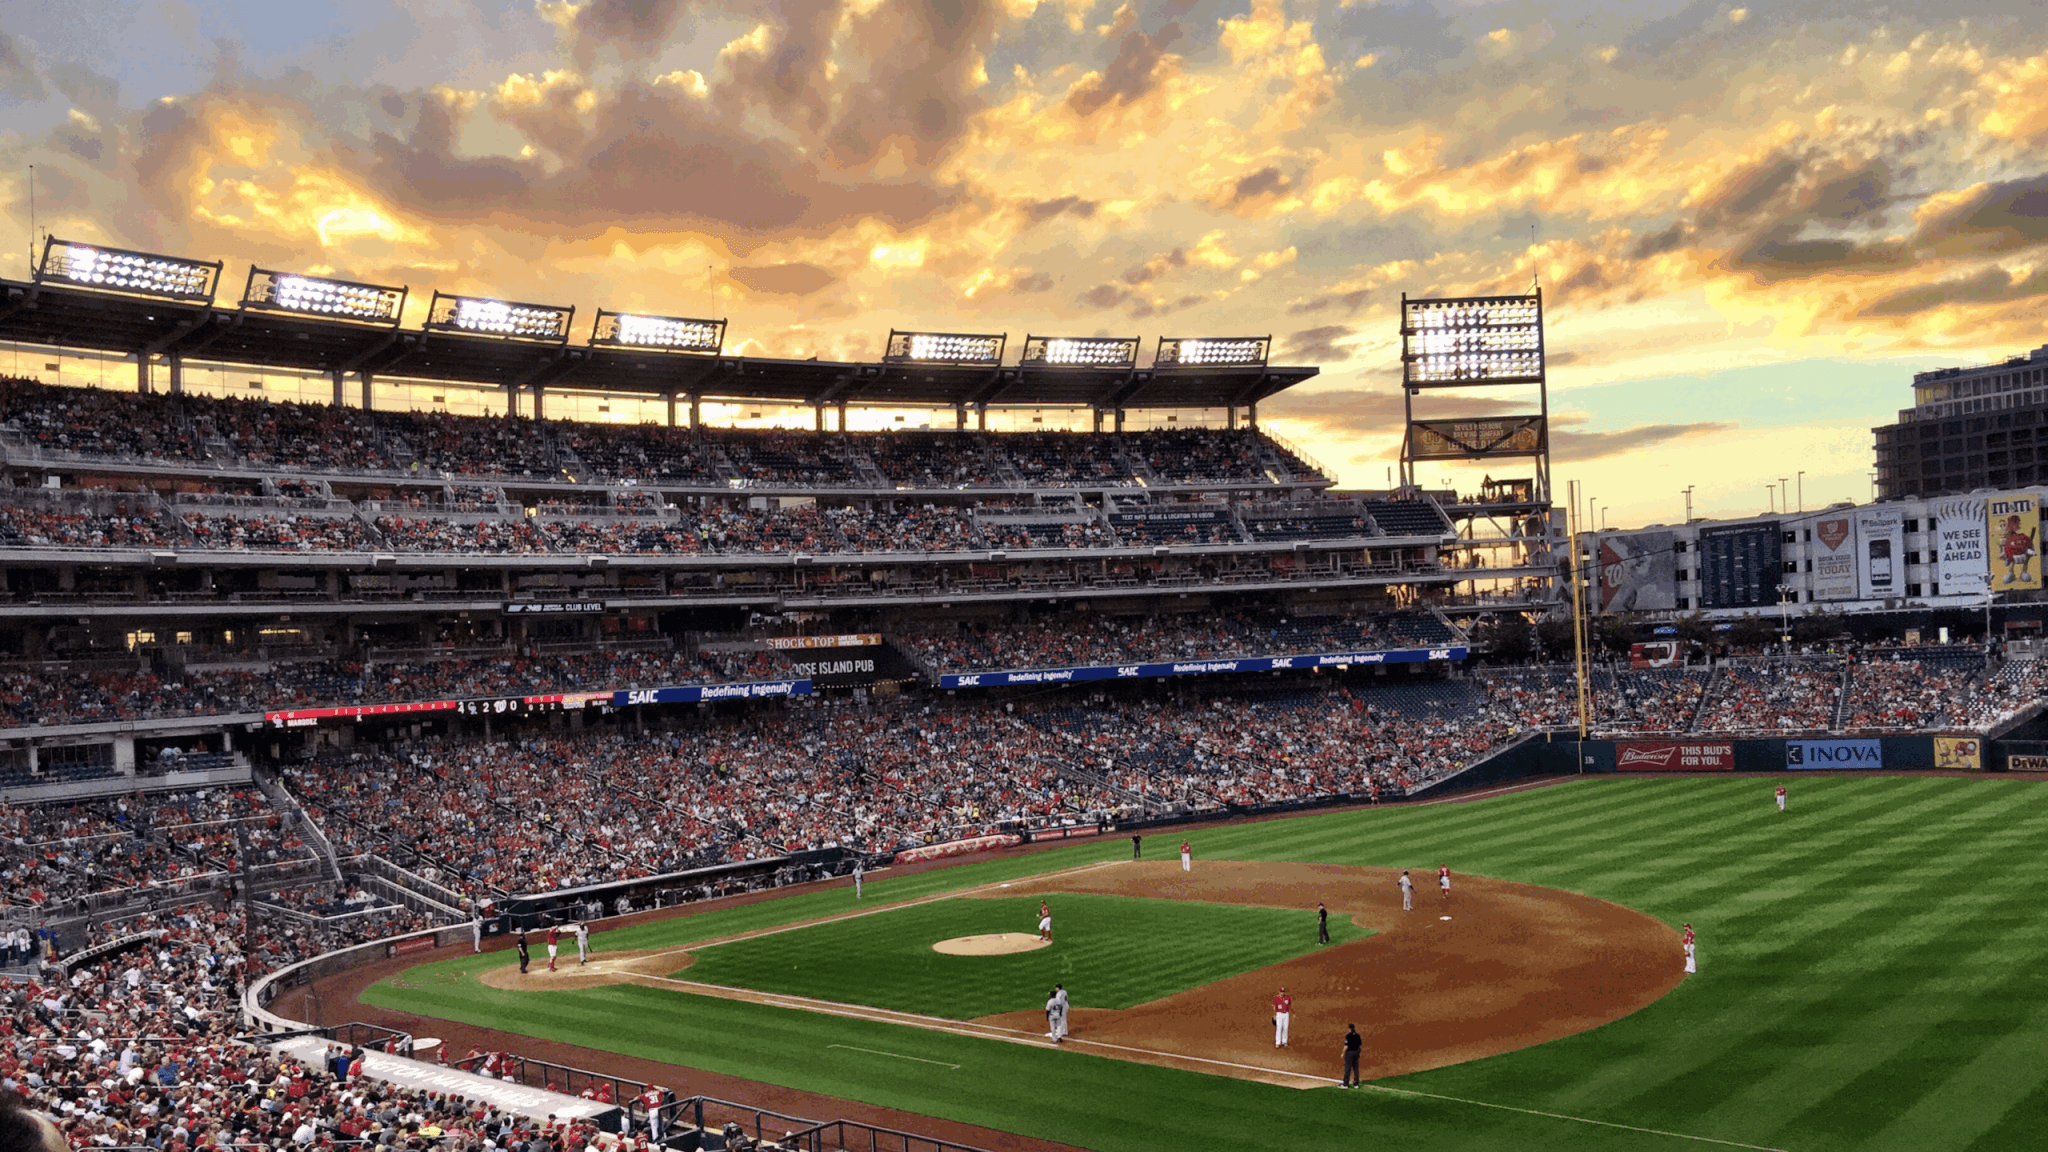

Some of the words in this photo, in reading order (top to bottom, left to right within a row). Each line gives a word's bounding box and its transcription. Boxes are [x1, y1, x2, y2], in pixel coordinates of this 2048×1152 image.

[1943, 531, 1960, 540] WE
[1962, 529, 1981, 539] SEE
[1945, 542, 1952, 551] A
[1956, 540, 1979, 550] WIN
[1944, 550, 1981, 561] AHEAD
[1818, 564, 1851, 574] TODAY
[566, 603, 582, 611] CLUB
[584, 603, 602, 611] LEVEL
[766, 638, 805, 649] SHOCK
[812, 636, 834, 647] TOP
[1428, 650, 1450, 660] SAIC
[819, 660, 853, 674] ISLAND
[855, 660, 875, 672] PUB
[1271, 658, 1293, 668] SAIC
[1117, 666, 1139, 677] SAIC
[957, 675, 980, 686] SAIC
[701, 683, 750, 698] Redefining
[628, 690, 659, 704] SAIC
[483, 702, 489, 713] 2
[510, 700, 517, 711] 0
[1680, 746, 1701, 755] THIS
[1810, 746, 1879, 761] INOVA
[1625, 751, 1669, 762] Budweiser
[1681, 756, 1699, 765] FOR
[1700, 756, 1722, 765] YOU.
